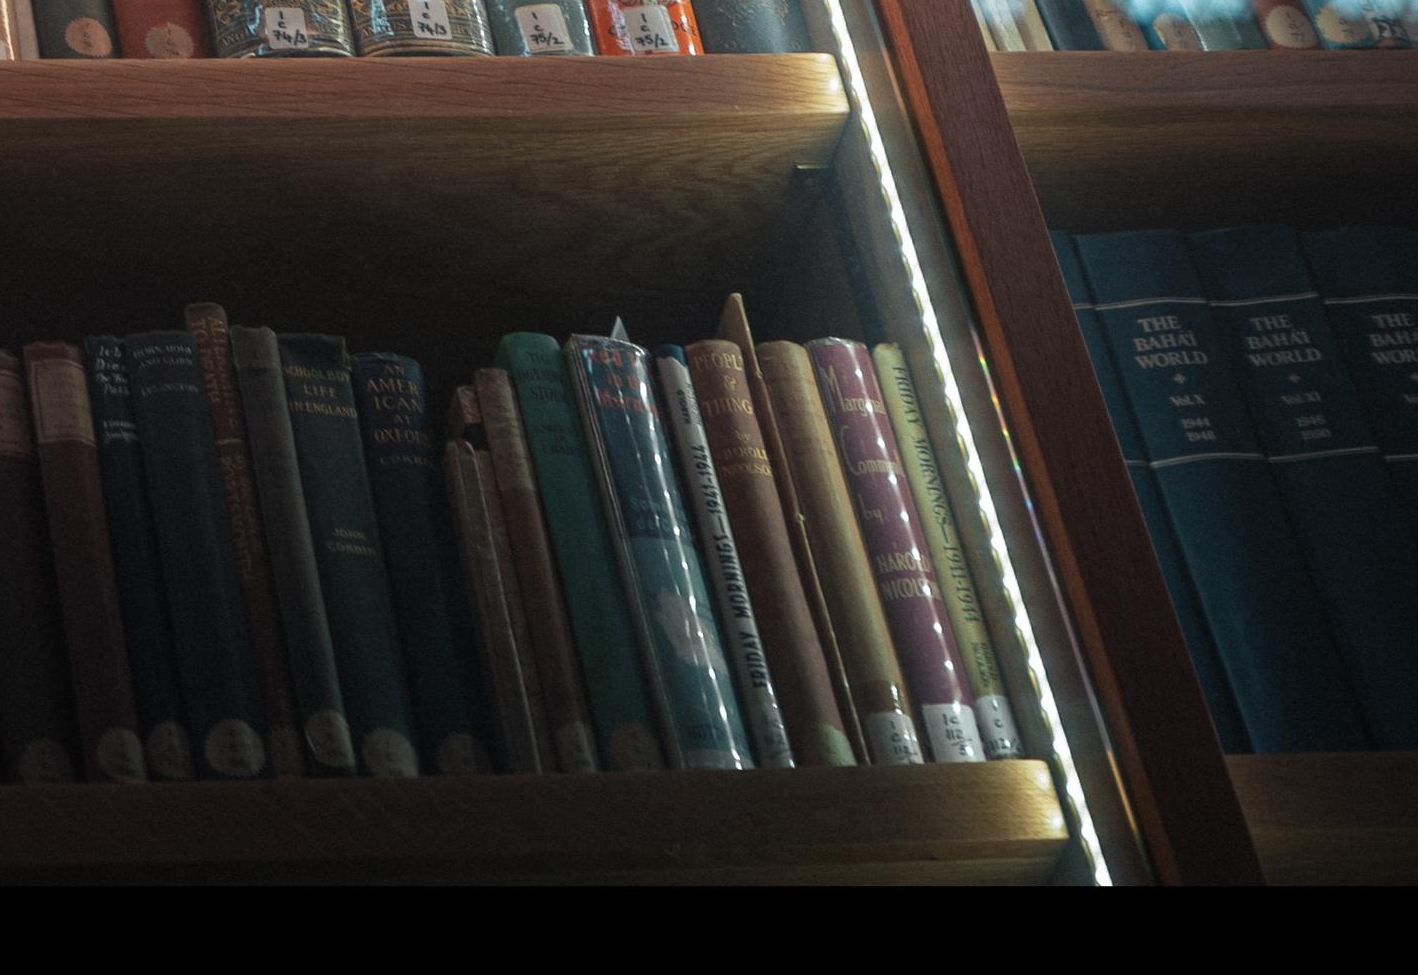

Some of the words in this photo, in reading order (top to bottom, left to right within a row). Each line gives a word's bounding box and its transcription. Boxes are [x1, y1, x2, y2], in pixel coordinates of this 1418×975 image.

[1136, 315, 1181, 333] THE
[1249, 314, 1294, 331] THE
[1371, 313, 1414, 329] THE
[1369, 331, 1418, 348] BAH
[1134, 350, 1208, 369] WORLD
[1248, 347, 1323, 367] WORLD
[384, 364, 405, 375] AN
[303, 384, 338, 399] LIFE
[366, 378, 419, 397] AMER
[892, 365, 920, 425] FRIDAY
[305, 401, 358, 419] ENGLAND
[373, 396, 425, 415] ICAN
[394, 415, 411, 425] AT
[1181, 417, 1211, 430] 1944
[858, 493, 883, 523] by
[331, 527, 365, 540] JOHN
[326, 541, 377, 556] CORBIN
[876, 554, 930, 574] HAROLD
[738, 630, 767, 689] FRIDAY
